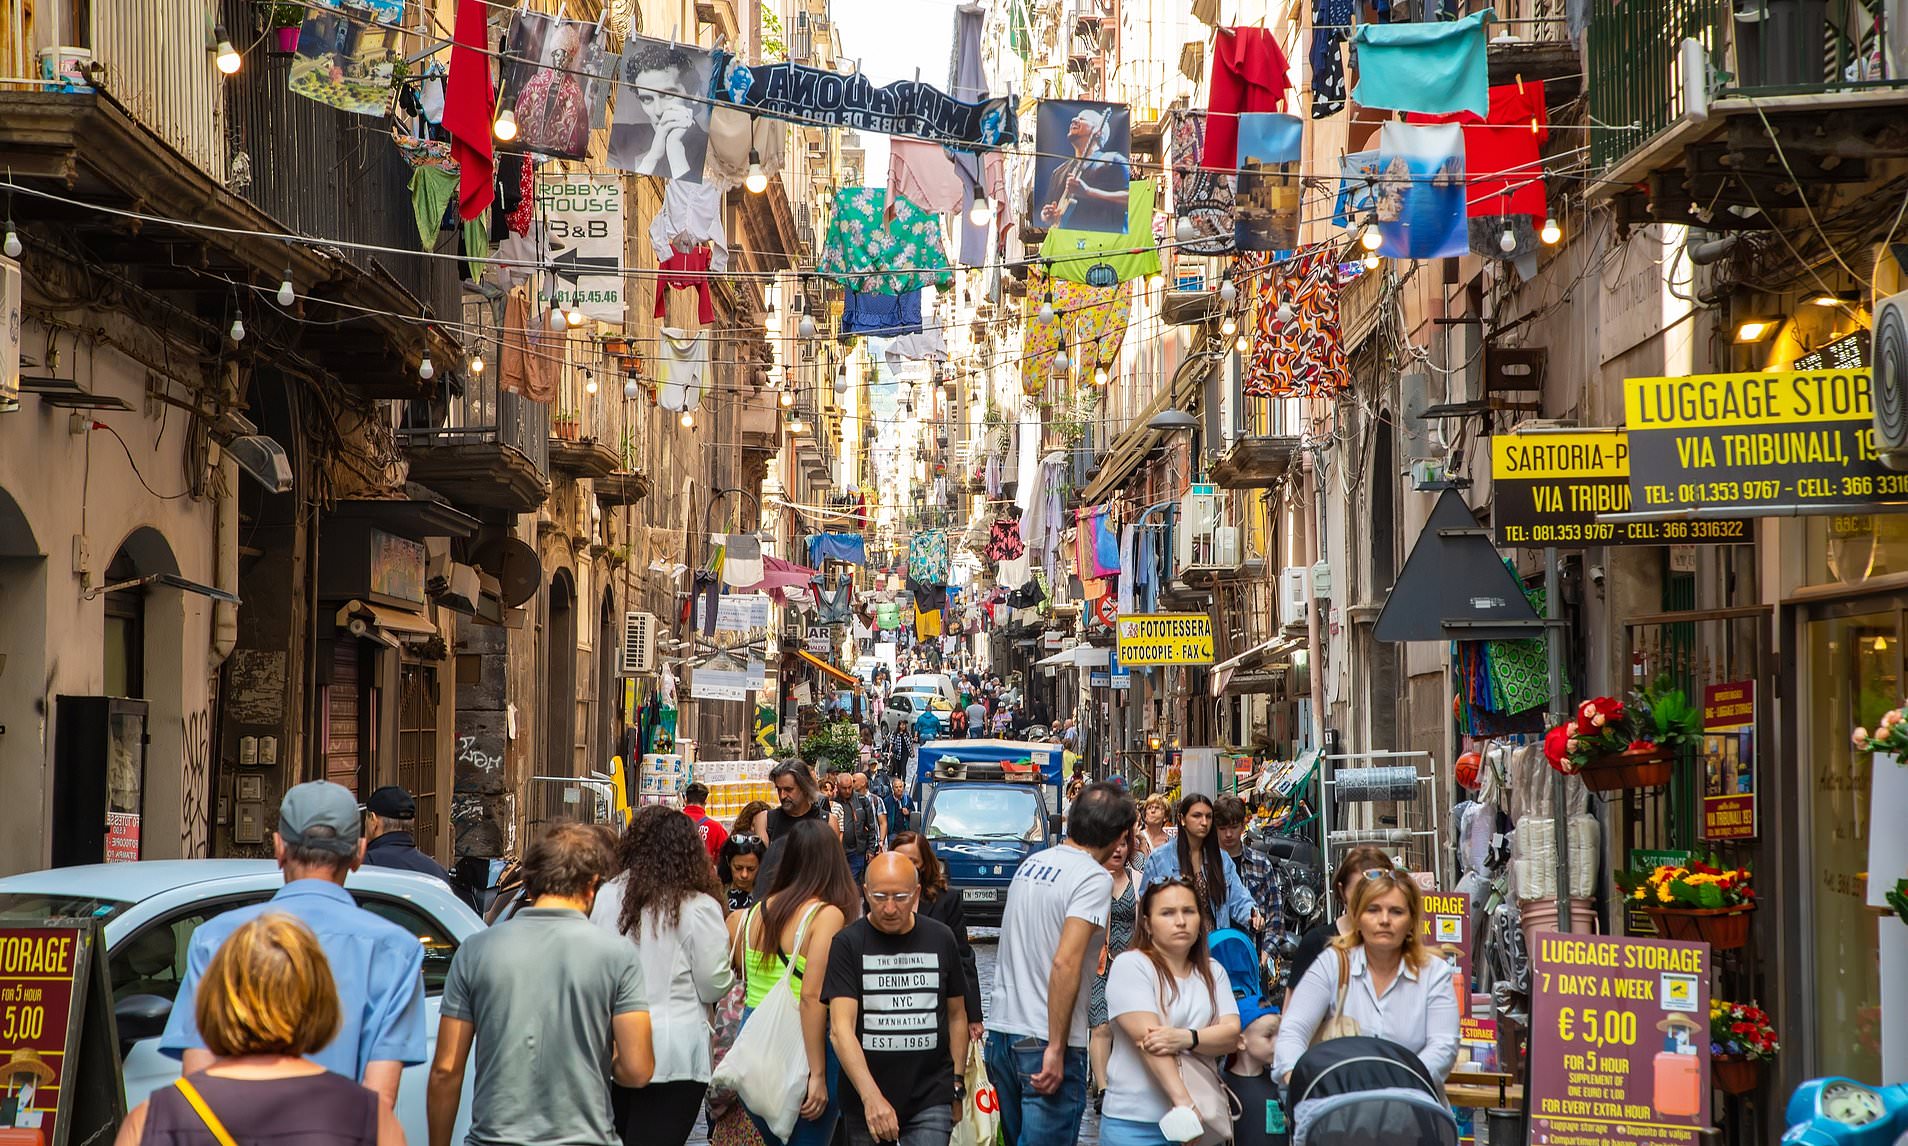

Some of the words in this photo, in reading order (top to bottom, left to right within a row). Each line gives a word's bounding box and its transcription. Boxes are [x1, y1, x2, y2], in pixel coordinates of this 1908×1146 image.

[539, 184, 618, 195] ROBBY'S
[540, 199, 618, 211] HOUSE
[550, 220, 608, 237] B&B
[1640, 379, 1781, 422] LUGGAGE
[1507, 444, 1627, 471] SARTORIA-P
[1676, 437, 1716, 468] VIA
[1722, 431, 1849, 466] TRIBUNALI,
[1533, 486, 1563, 512] VIA
[1644, 486, 1673, 504] TEL:
[1681, 483, 1739, 502] 081.353
[1743, 481, 1779, 499] 9767
[1798, 479, 1836, 497] CELL:
[1843, 477, 1871, 495] 366
[1505, 526, 1529, 541] TEL:
[1533, 524, 1580, 540] 081.353
[1585, 524, 1613, 539] 9767
[1628, 523, 1659, 538] CELL:
[1663, 522, 1687, 537] 366
[1691, 521, 1743, 536] 3316322
[1141, 620, 1210, 637] FOTOTESSERA
[1122, 646, 1172, 659] FOTOCOPIE
[1183, 645, 1198, 658] FAX
[1421, 896, 1464, 914] ORAGE
[1542, 939, 1620, 967] LUGGAGE
[1624, 945, 1703, 972] STORAGE
[879, 976, 909, 987] DENIM
[914, 975, 928, 985] CO.
[1542, 973, 1551, 993] 7
[1559, 974, 1597, 997] DAYS
[1600, 977, 1610, 997] A
[1614, 978, 1654, 1000] WEEK
[2, 988, 14, 1001] FOR
[16, 984, 22, 1001] 5
[24, 988, 42, 1001] HOUR
[893, 996, 912, 1007] NYC
[3, 1006, 44, 1044] 5,00
[1558, 1007, 1575, 1040] €
[1582, 1008, 1637, 1048] 5,00
[872, 1037, 898, 1048] EST.
[904, 1036, 929, 1047] 1965
[1466, 1029, 1494, 1039] STORAGE
[1564, 1054, 1584, 1071] FOR
[1587, 1051, 1596, 1072] 5
[1601, 1058, 1630, 1074] HOUR
[1568, 1073, 1613, 1085] SUPPLEMENT
[1615, 1076, 1624, 1086] OF
[1568, 1086, 1580, 1098] ONE
[1583, 1087, 1601, 1098] EURO
[1542, 1098, 1560, 1113] FOR
[1562, 1099, 1592, 1115] EVERY
[1594, 1102, 1623, 1117] EXTRA
[1625, 1104, 1650, 1120] HOUR
[1550, 1120, 1578, 1131] Luggage
[1582, 1122, 1608, 1133] storage
